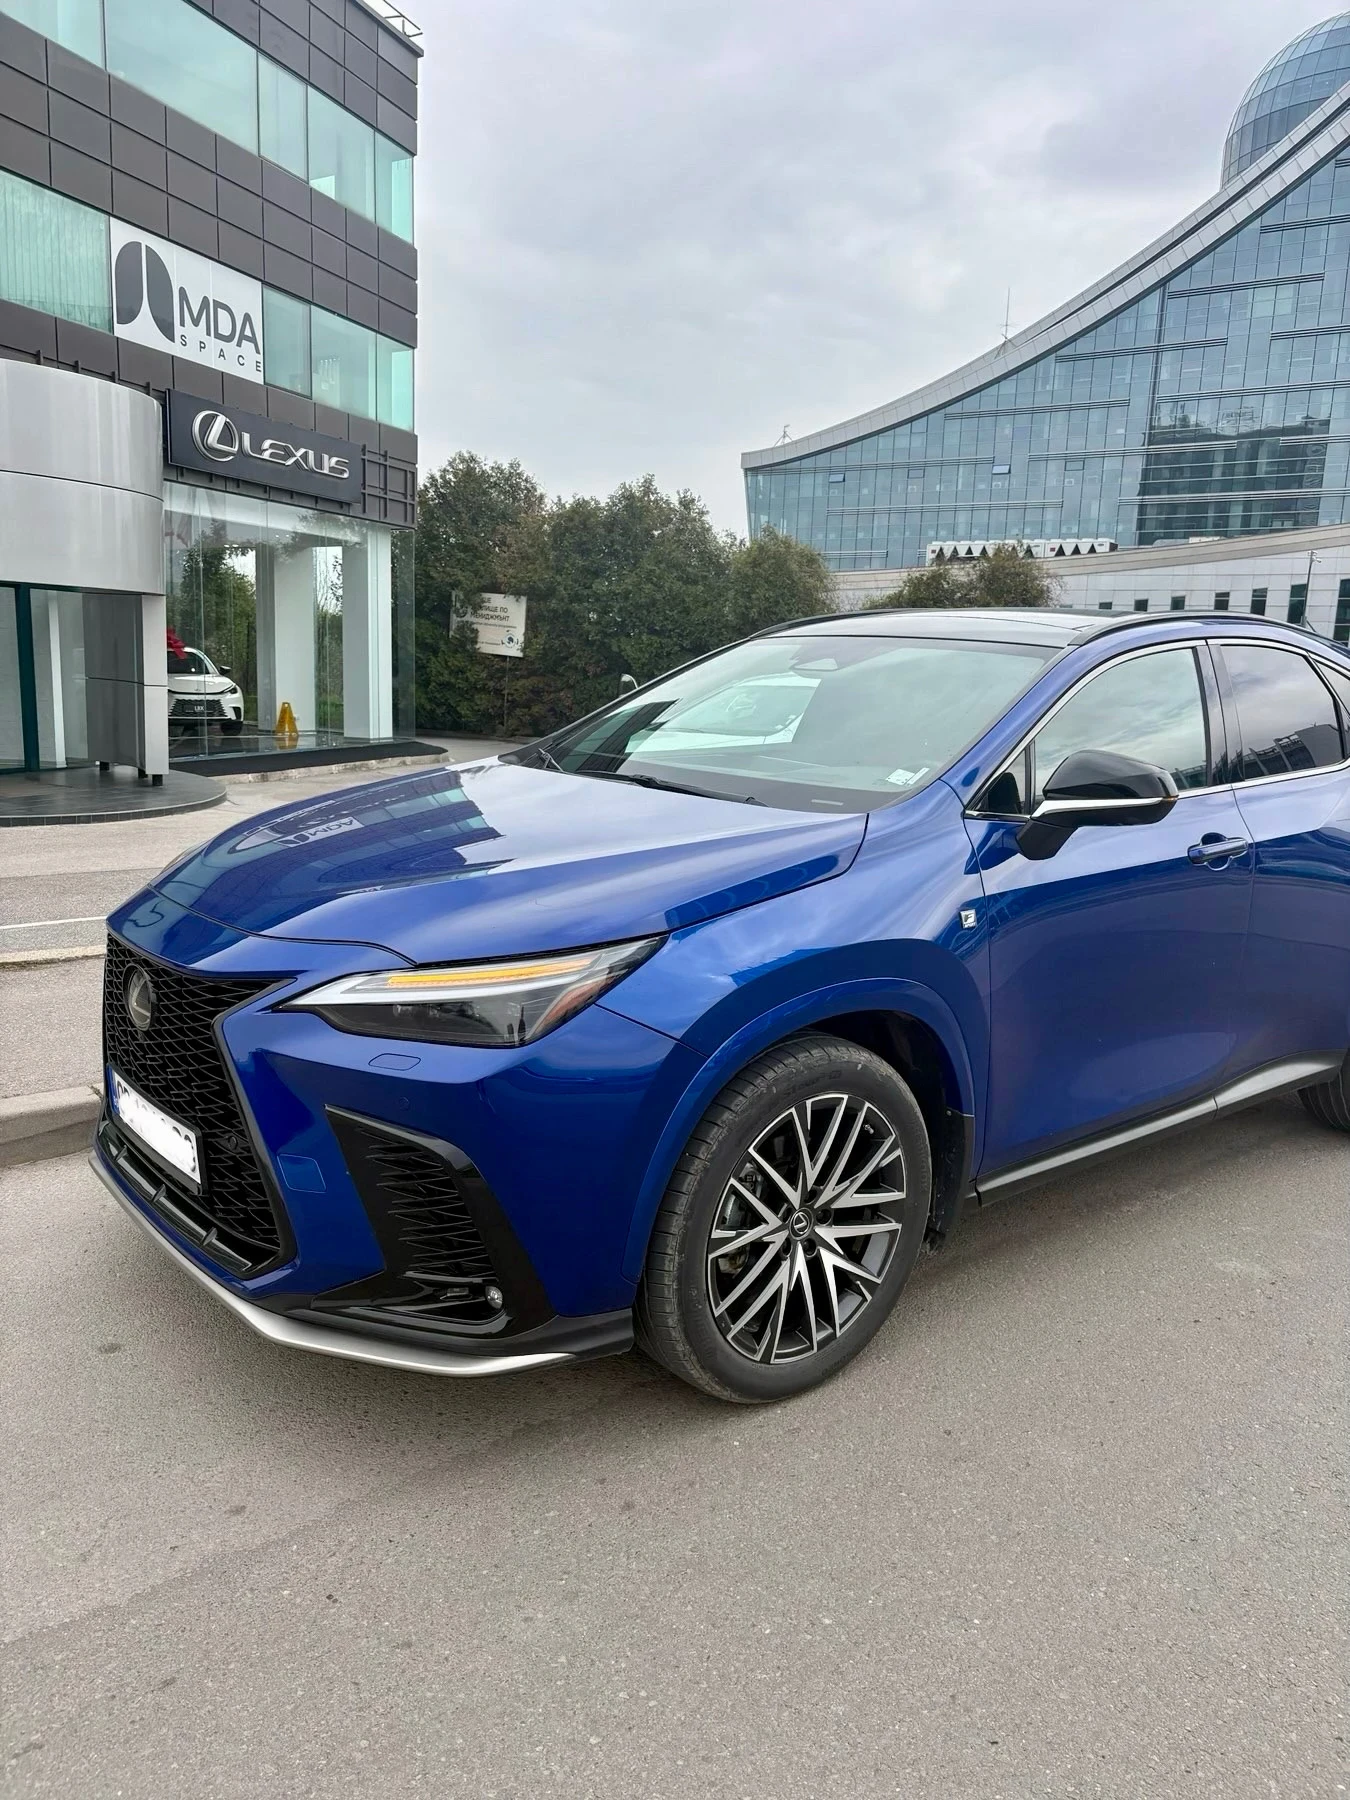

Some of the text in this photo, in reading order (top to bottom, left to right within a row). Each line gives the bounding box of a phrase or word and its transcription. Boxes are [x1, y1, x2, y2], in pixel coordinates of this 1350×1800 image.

[178, 286, 261, 355] MDA
[180, 334, 262, 373] SPACE
[241, 431, 350, 479] LEXUS
